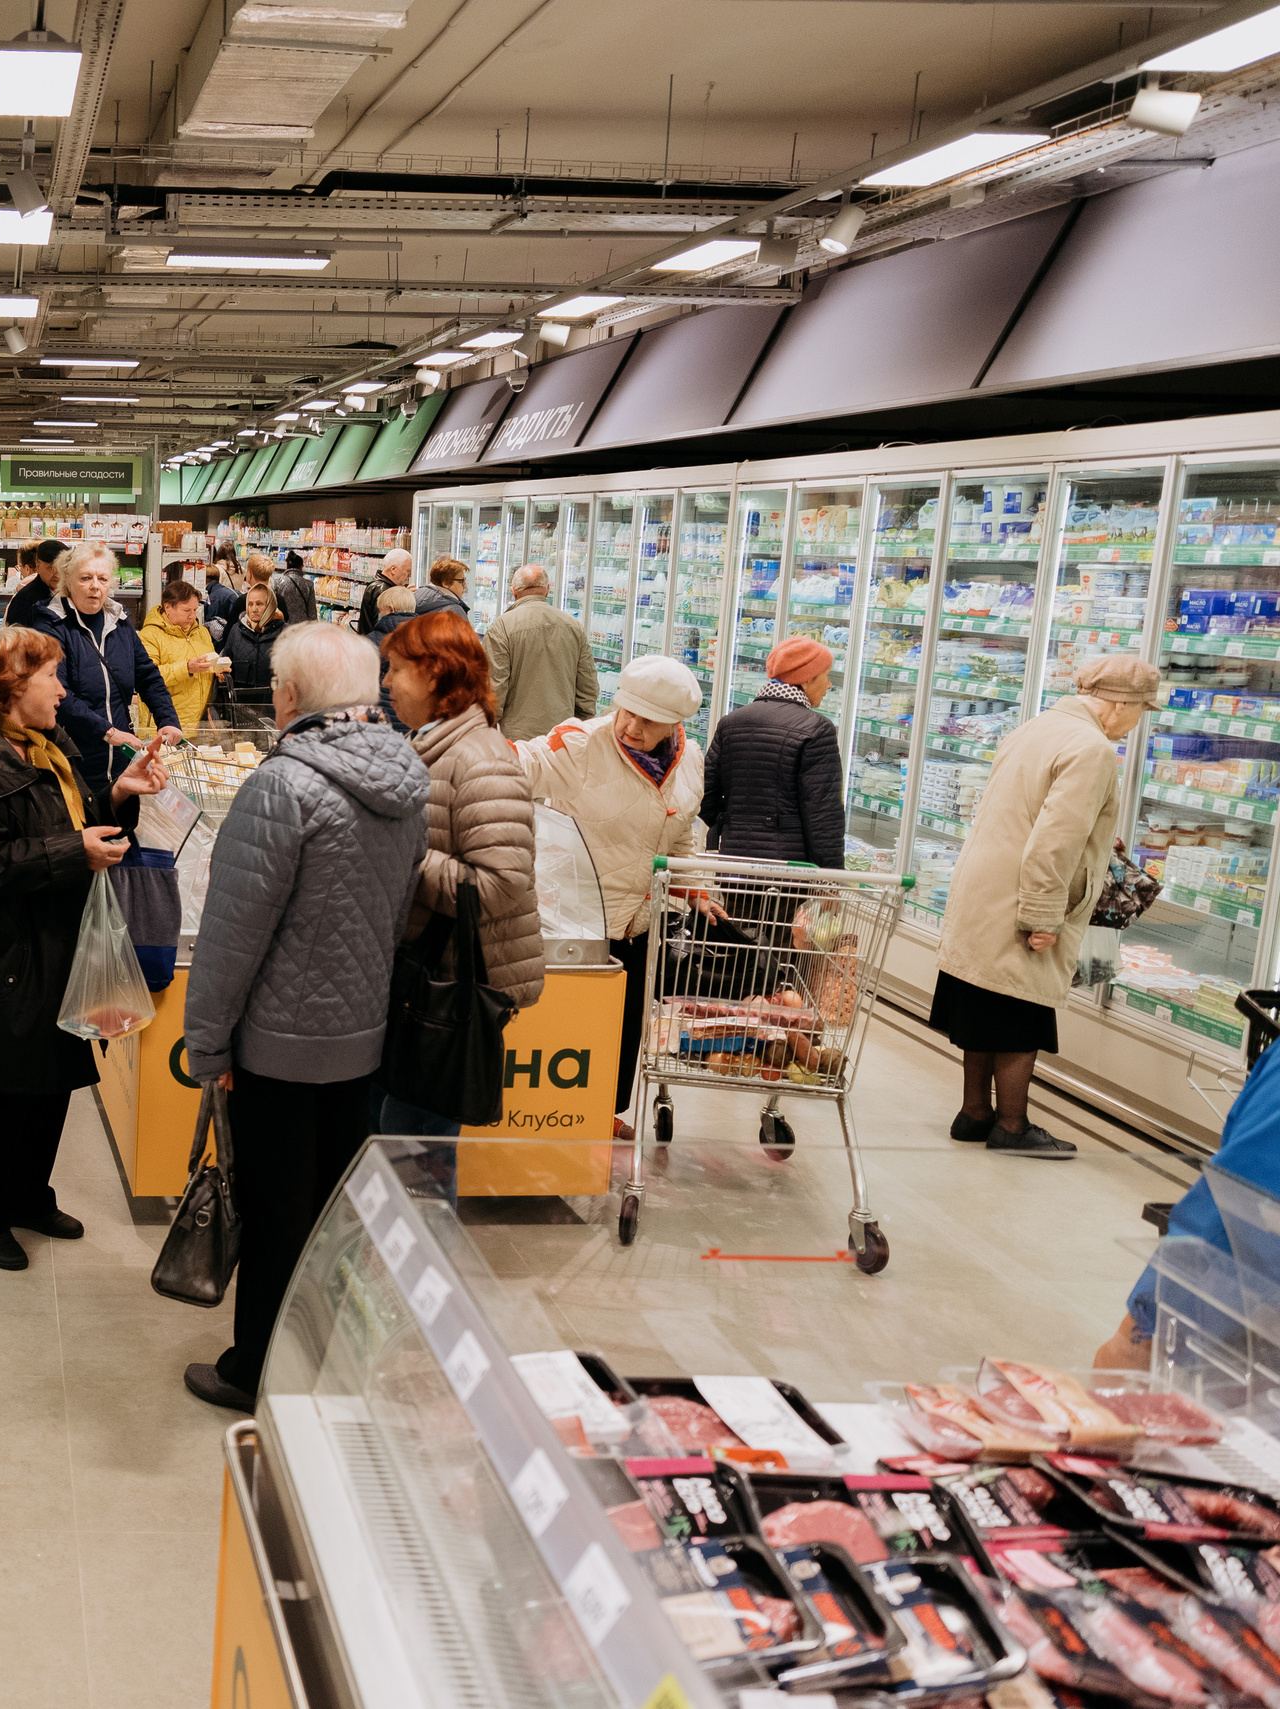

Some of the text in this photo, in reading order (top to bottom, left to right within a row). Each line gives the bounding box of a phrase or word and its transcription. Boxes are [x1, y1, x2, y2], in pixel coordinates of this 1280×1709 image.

[417, 402, 584, 461] МОЛОЧНЫЕ ПРОДУКТЫ
[18, 468, 125, 480] Правильные сладости
[507, 1109, 585, 1132] Клуба»
